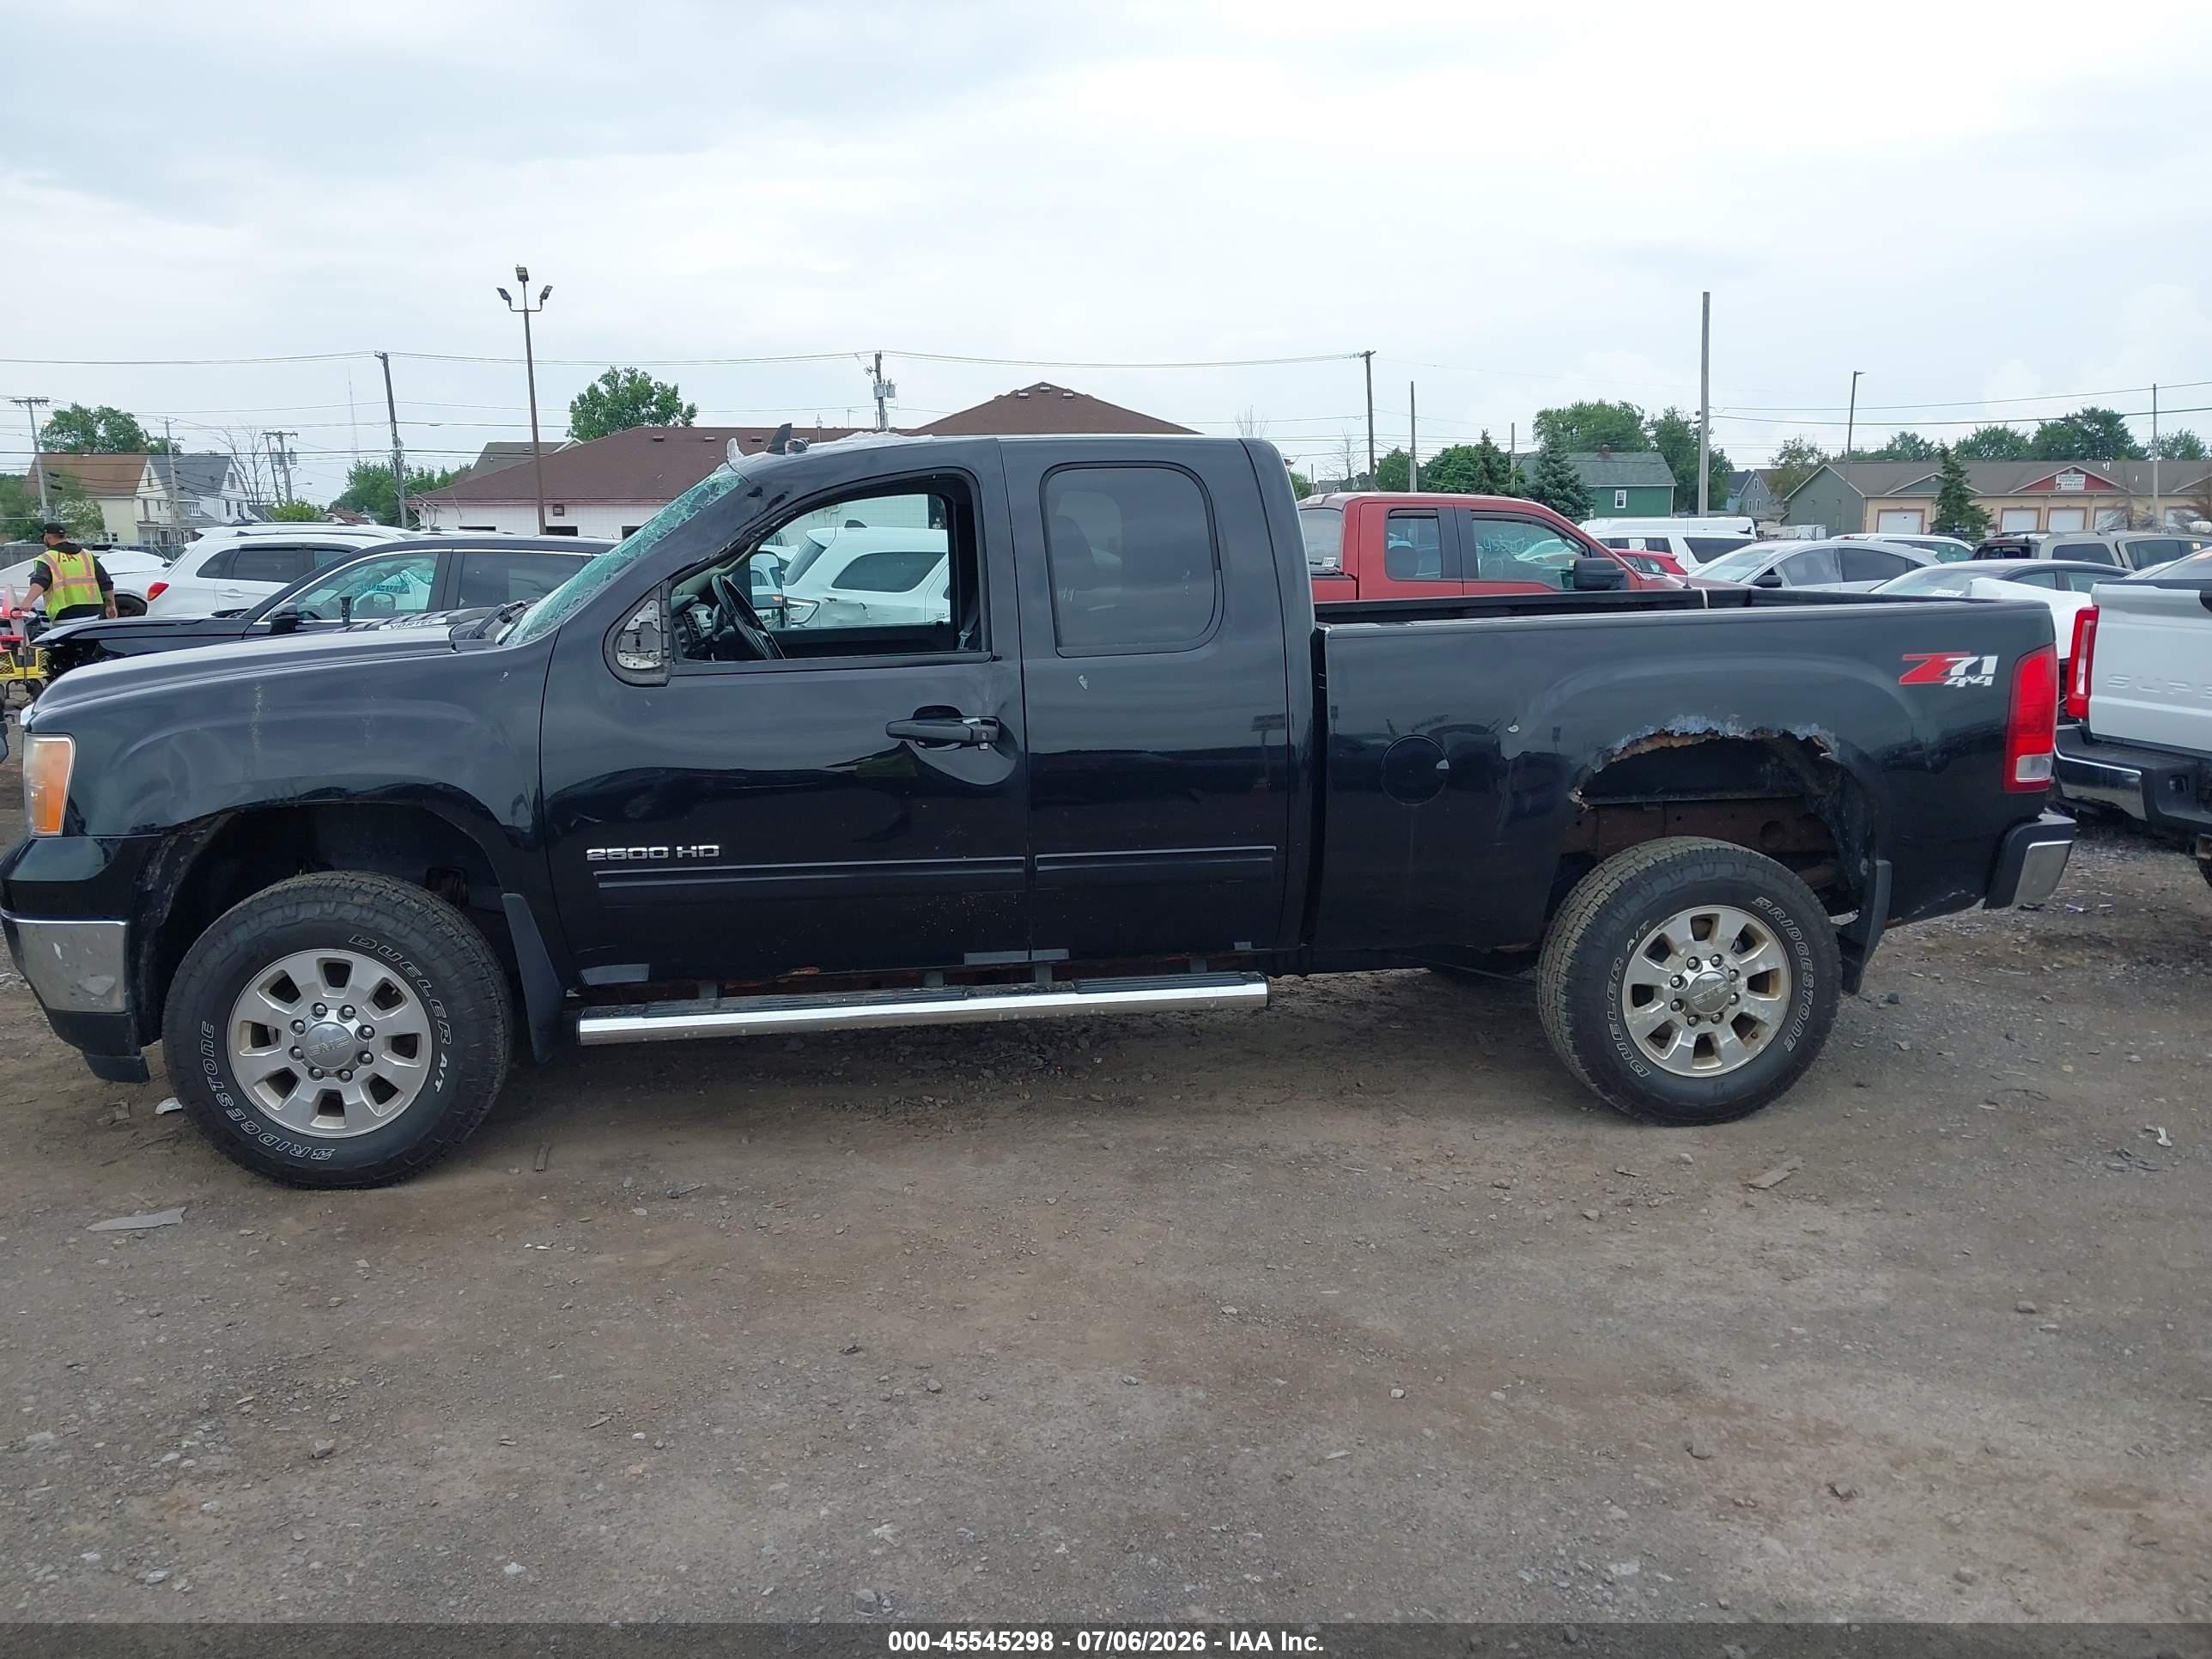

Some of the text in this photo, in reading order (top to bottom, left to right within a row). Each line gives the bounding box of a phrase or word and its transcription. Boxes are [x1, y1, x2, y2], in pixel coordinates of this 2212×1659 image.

[1899, 652, 1999, 685] Z71
[586, 844, 720, 861] 2500 HD
[349, 934, 452, 1045] DUELER
[1607, 957, 1650, 1077] DUELER
[1753, 896, 1815, 1052] BRIDGESTONE
[200, 1021, 337, 1161] BRIDGESTONE
